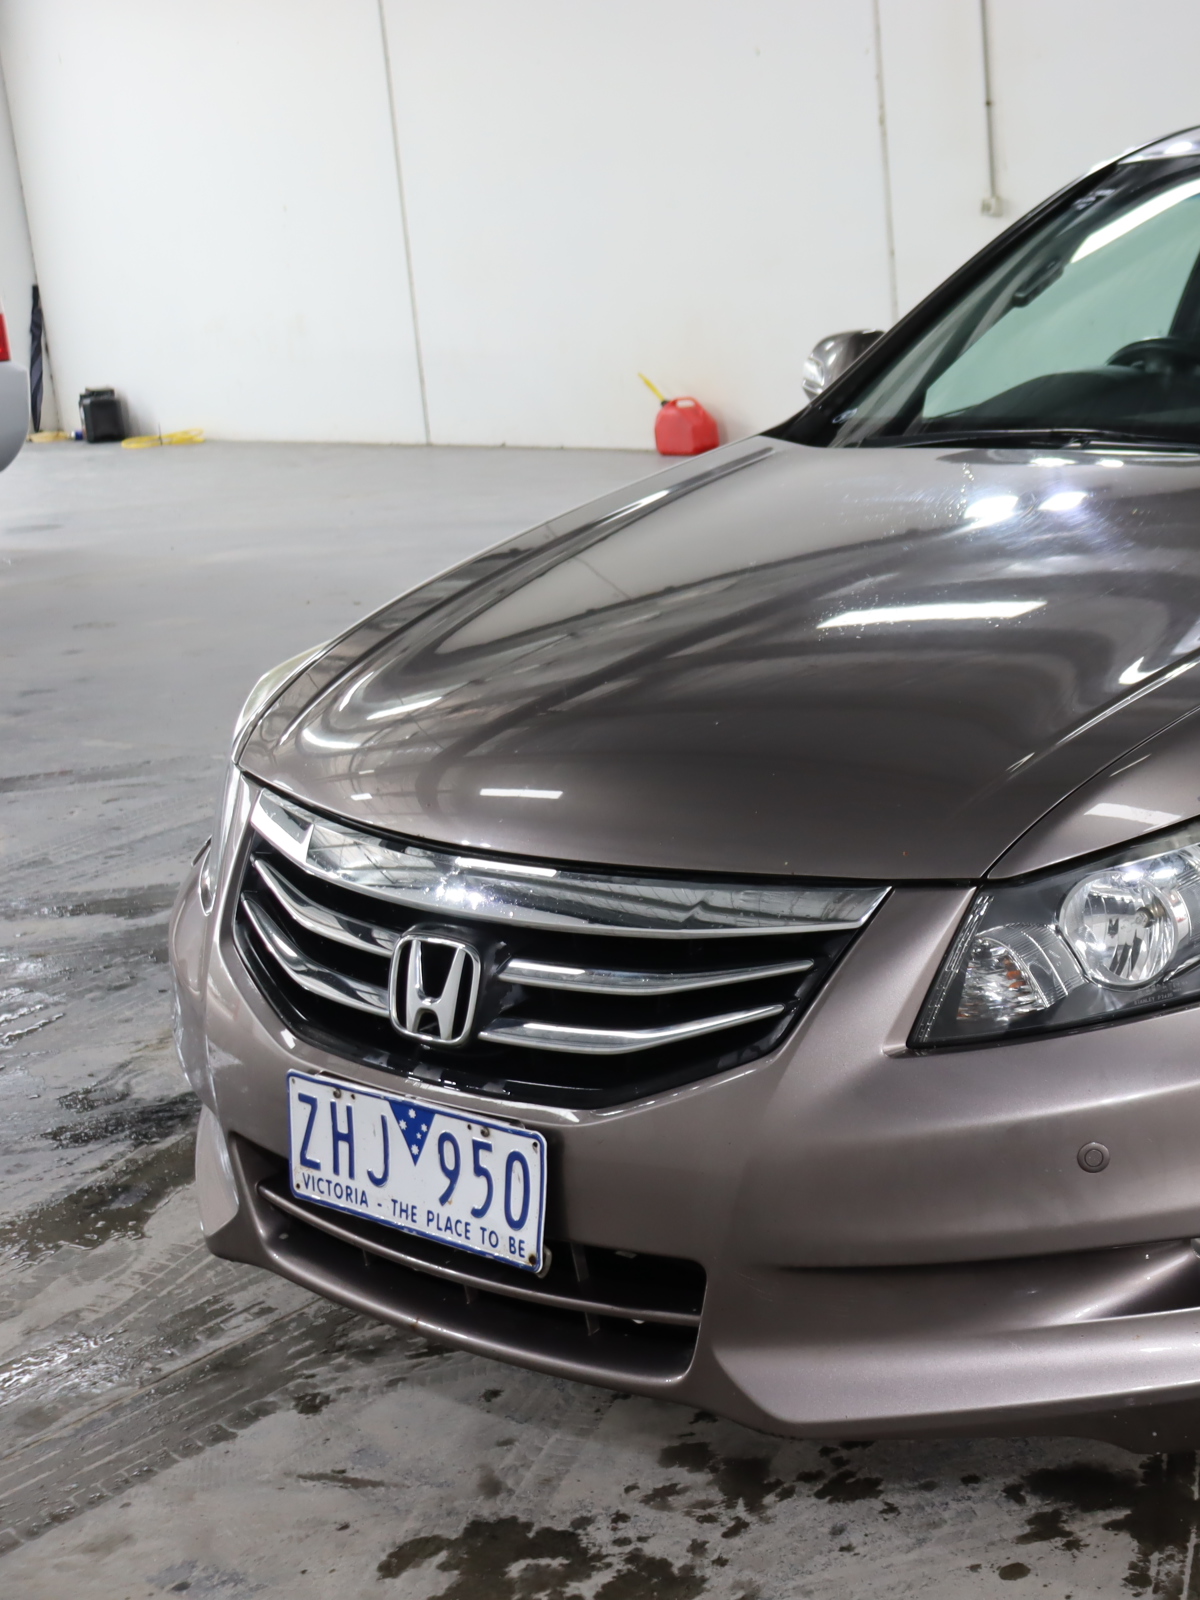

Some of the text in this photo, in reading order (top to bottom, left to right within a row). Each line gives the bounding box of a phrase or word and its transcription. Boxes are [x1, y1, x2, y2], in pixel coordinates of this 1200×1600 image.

[298, 1092, 530, 1231] ZHJ 950
[302, 1172, 369, 1208] VICTORIA
[391, 1198, 418, 1223] THE
[426, 1210, 471, 1240] PLACE
[480, 1226, 499, 1248] TO
[509, 1236, 526, 1258] BE
